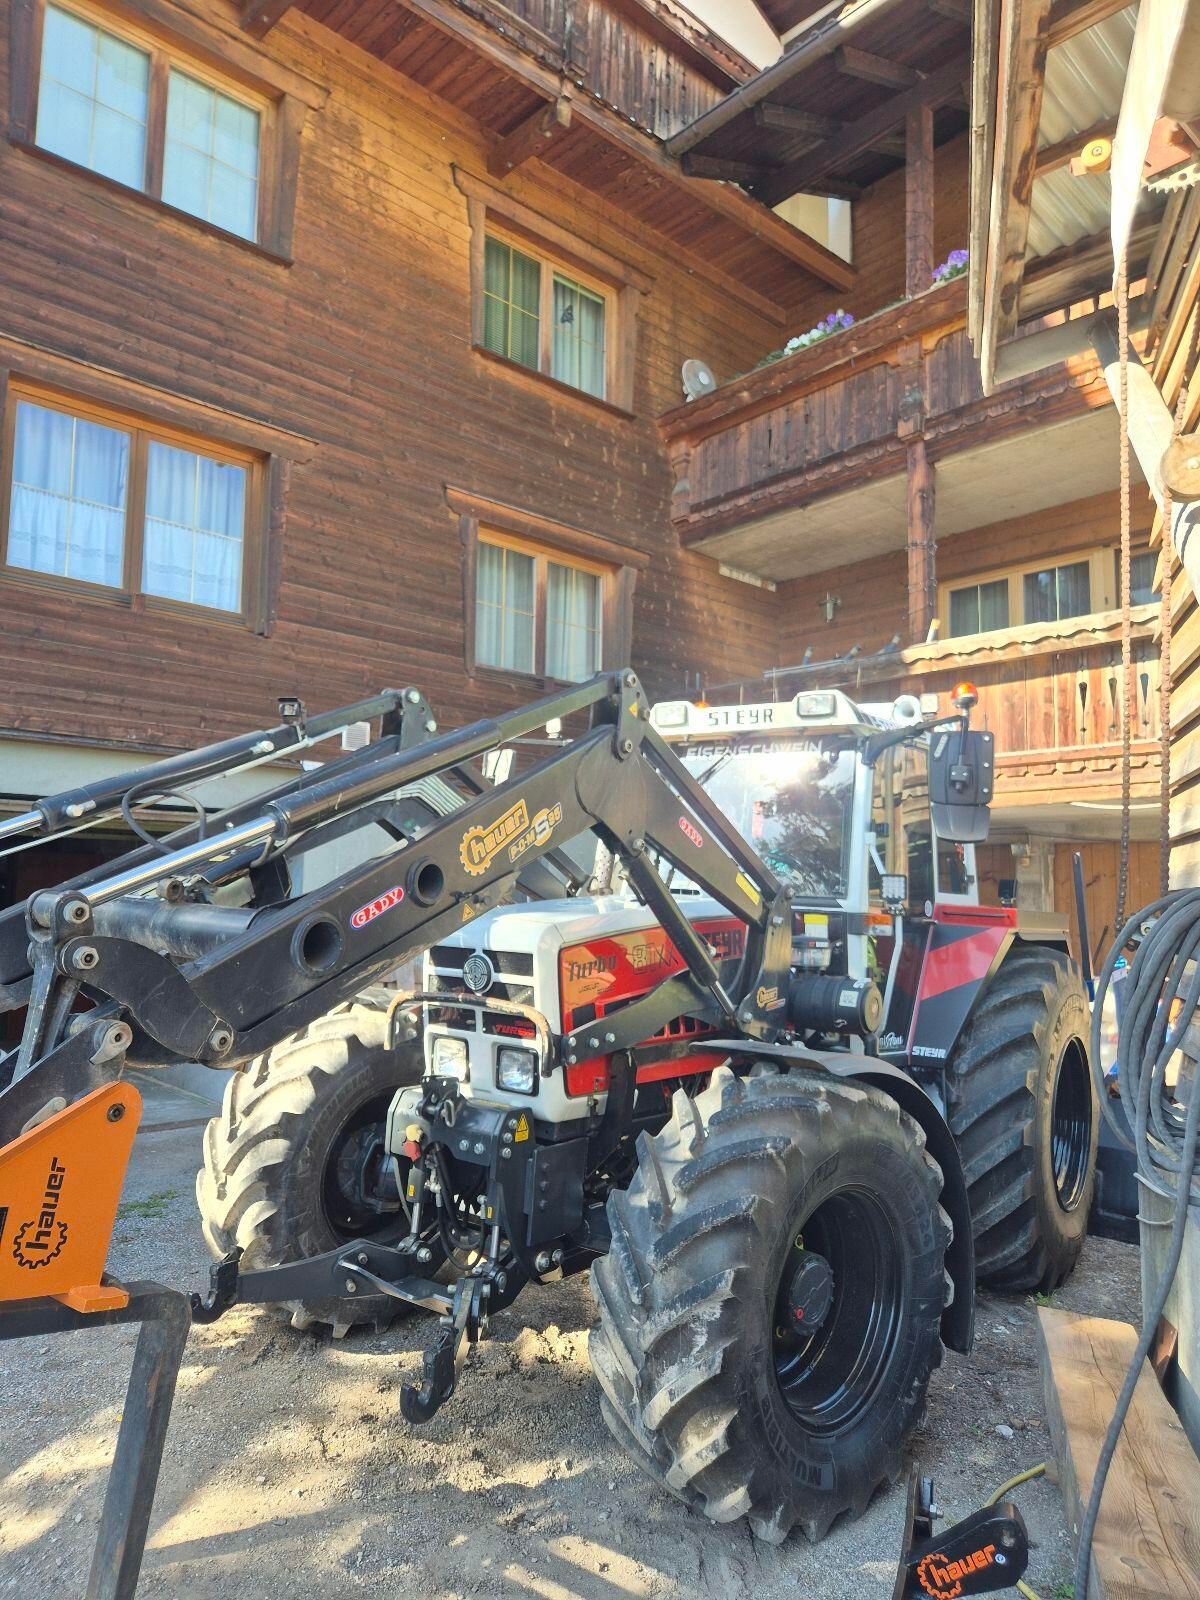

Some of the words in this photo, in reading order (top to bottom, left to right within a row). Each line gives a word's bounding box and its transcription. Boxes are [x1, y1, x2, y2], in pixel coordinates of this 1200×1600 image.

[708, 707, 773, 726] STEYR
[685, 739, 823, 758] EISENSCHWEIN
[470, 808, 524, 863] hauer
[354, 888, 403, 926] GADY
[911, 1045, 946, 1059] STEYR
[25, 1156, 66, 1250] hauer
[929, 1543, 996, 1588] hauer
